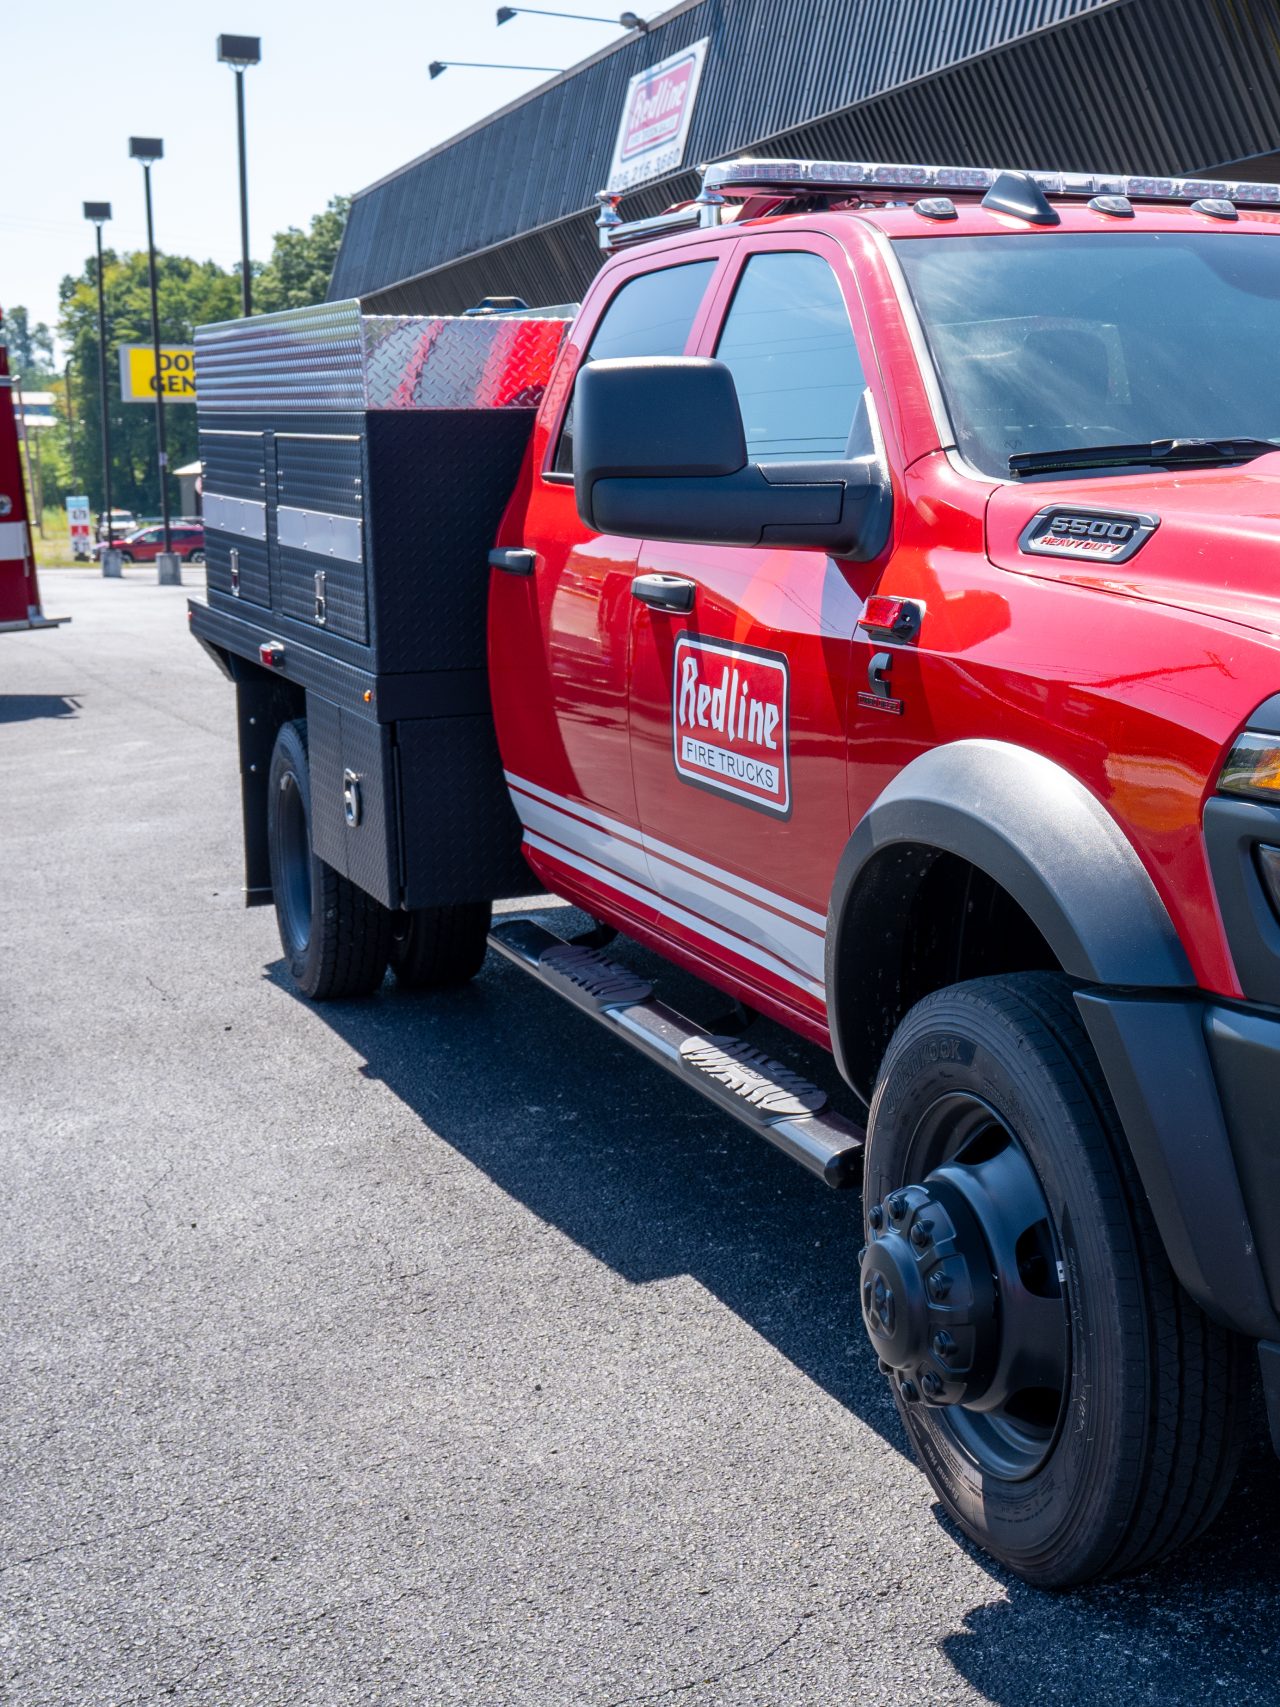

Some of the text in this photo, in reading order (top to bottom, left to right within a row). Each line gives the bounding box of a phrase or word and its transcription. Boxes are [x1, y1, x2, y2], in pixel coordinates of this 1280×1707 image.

[1050, 516, 1132, 540] 5500
[678, 656, 780, 750] Redline
[686, 741, 774, 788] FIRE TRUCKS
